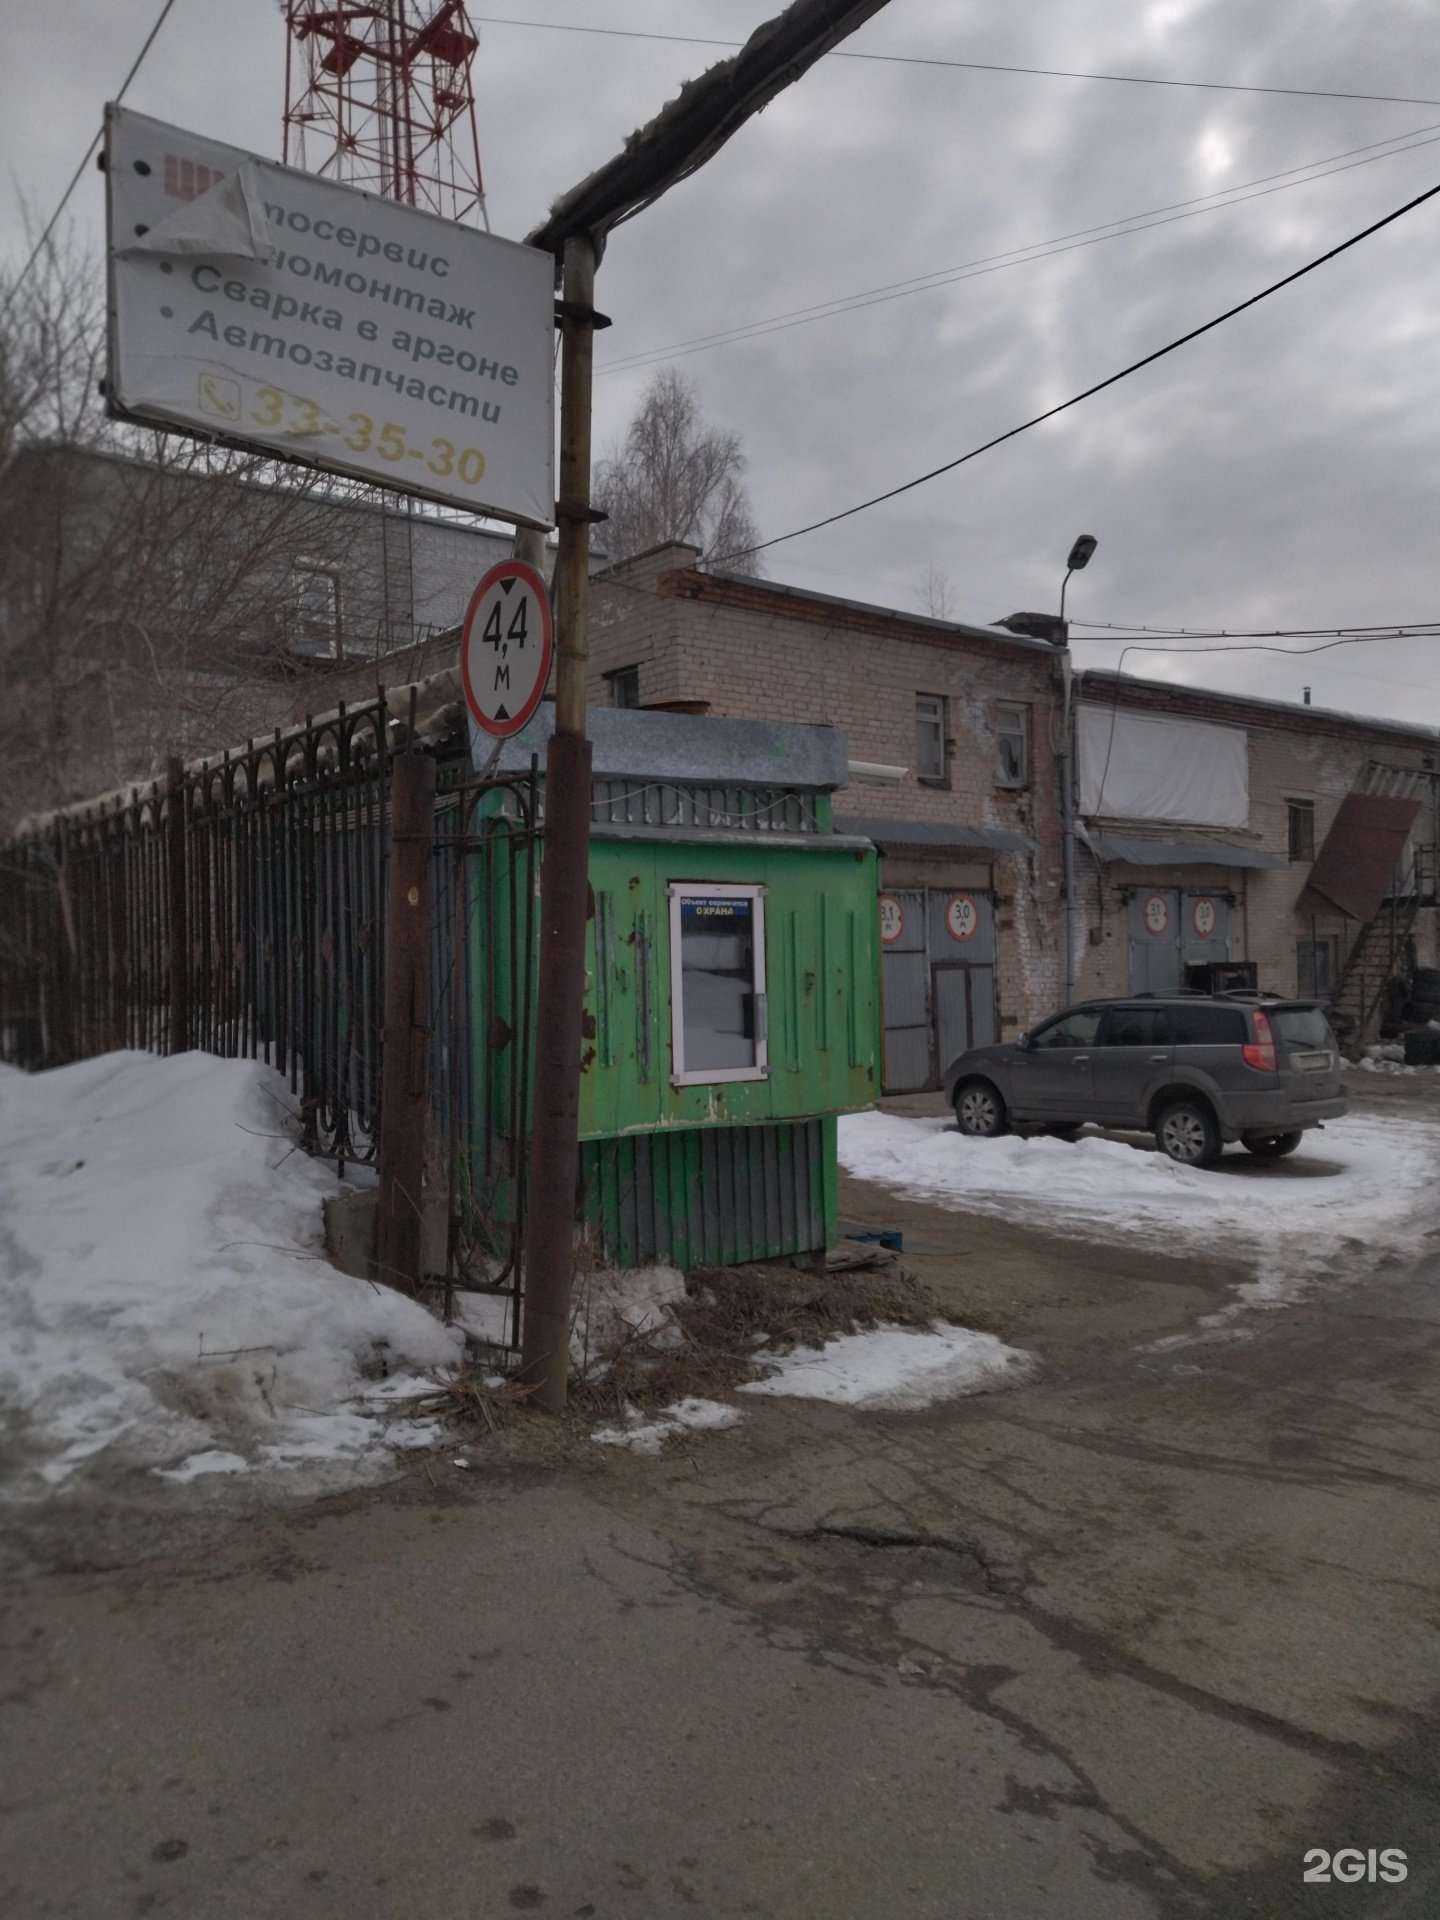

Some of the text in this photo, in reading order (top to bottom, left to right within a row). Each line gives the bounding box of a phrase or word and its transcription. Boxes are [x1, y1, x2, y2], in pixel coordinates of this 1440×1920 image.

[262, 201, 450, 277] тосервис
[190, 264, 520, 387] Сварка в аргоне
[262, 250, 477, 330] номонтаж
[187, 309, 502, 425] Автозапчасти
[250, 386, 488, 486] 33-35-30
[482, 595, 528, 659] 4,4
[696, 906, 735, 916] ОХРАНА
